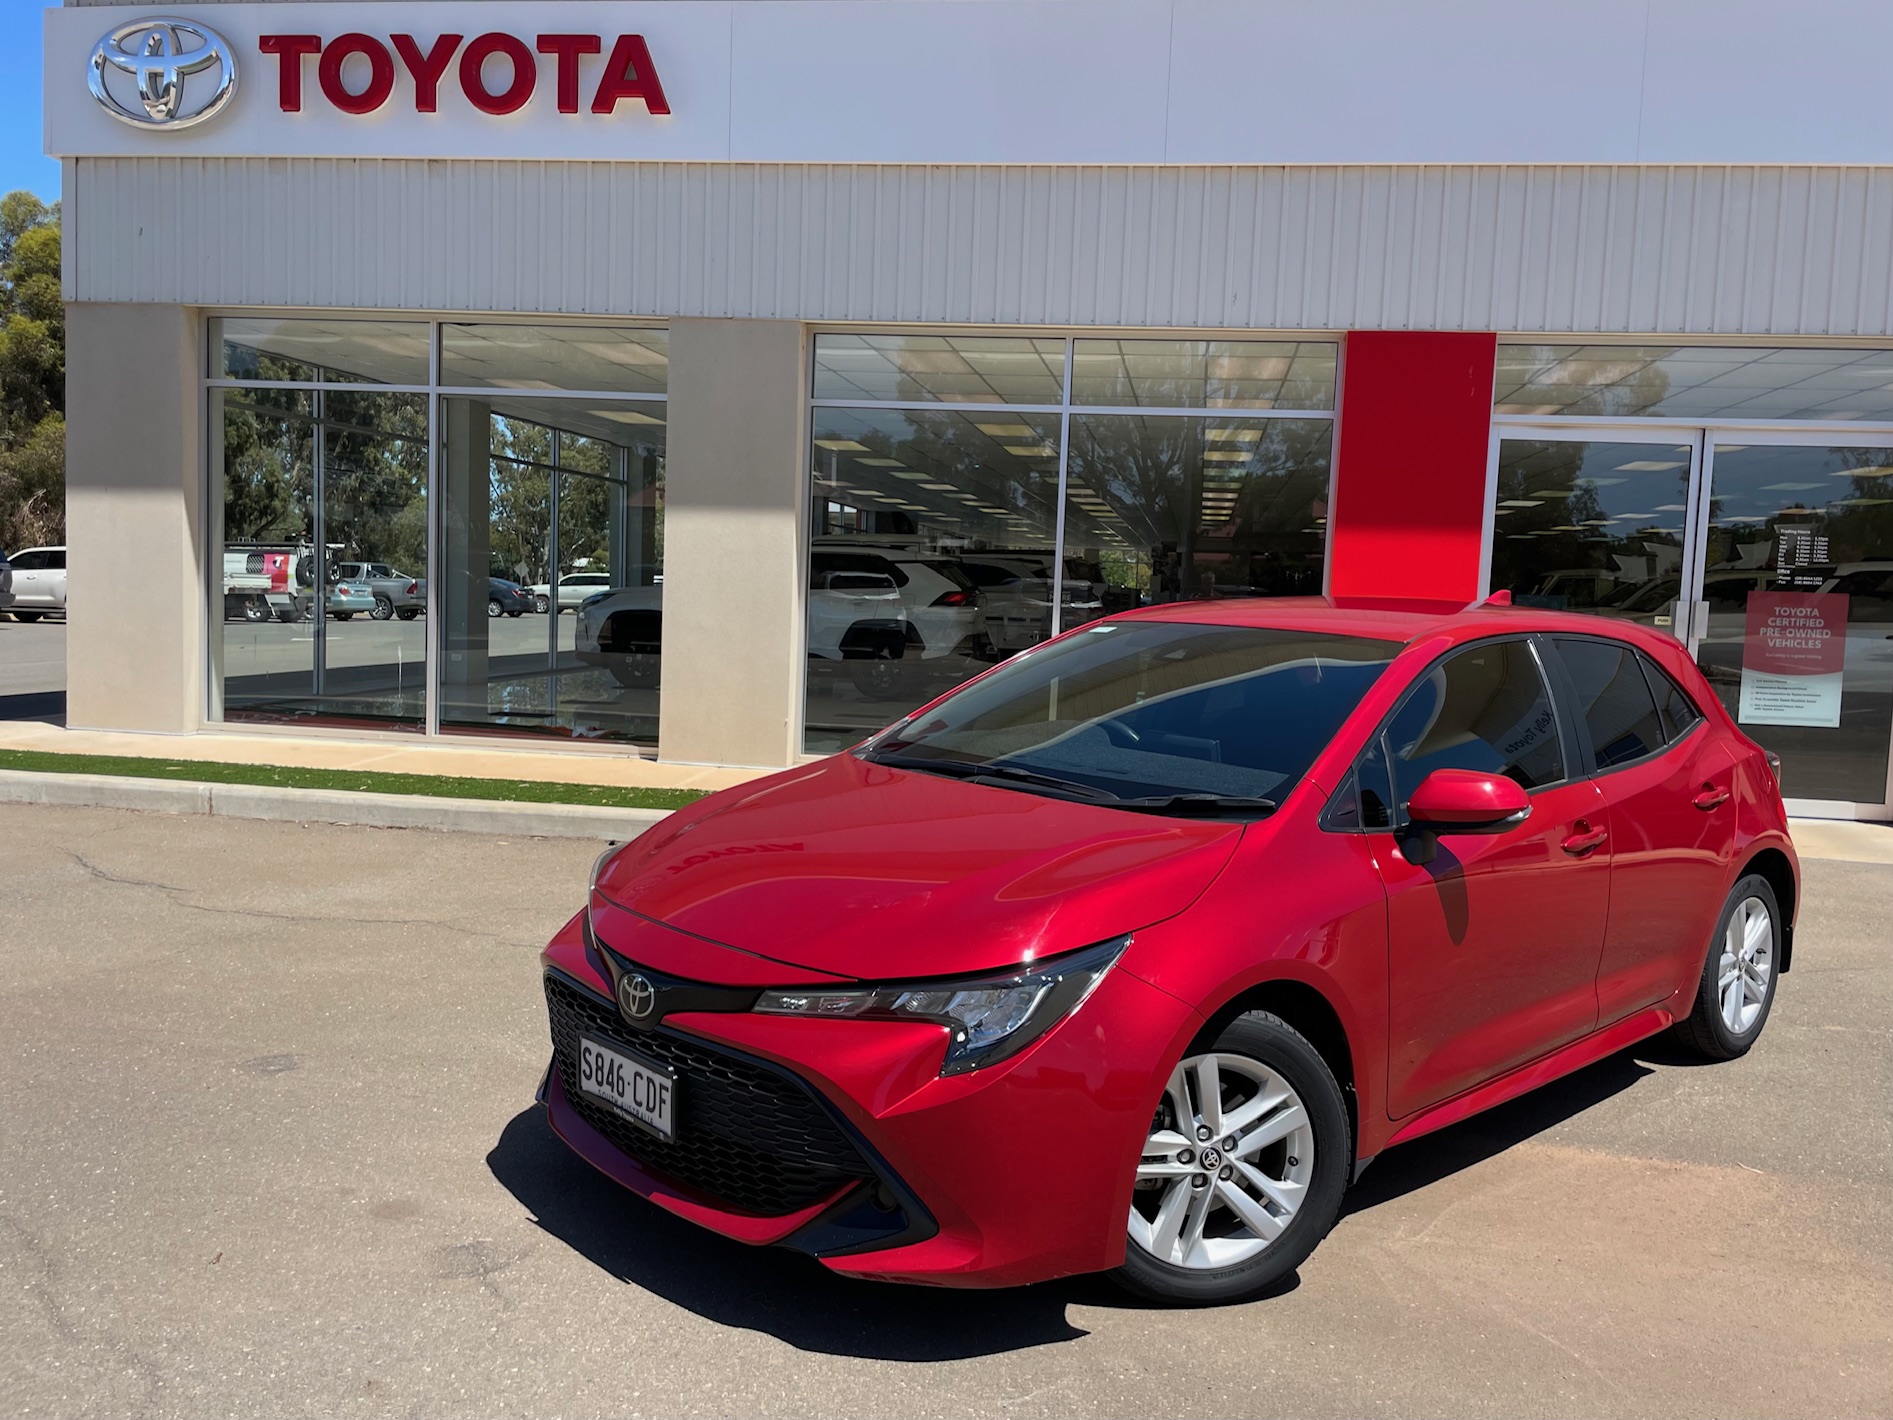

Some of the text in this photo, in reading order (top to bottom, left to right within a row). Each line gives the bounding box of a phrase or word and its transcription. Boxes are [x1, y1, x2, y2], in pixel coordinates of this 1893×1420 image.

[259, 32, 671, 115] TOYOTA
[1774, 606, 1820, 617] TOYOTA
[1767, 617, 1825, 628] CERTIFIED
[1759, 627, 1832, 639] PRE-OWNED
[1767, 638, 1822, 649] VEHICLES
